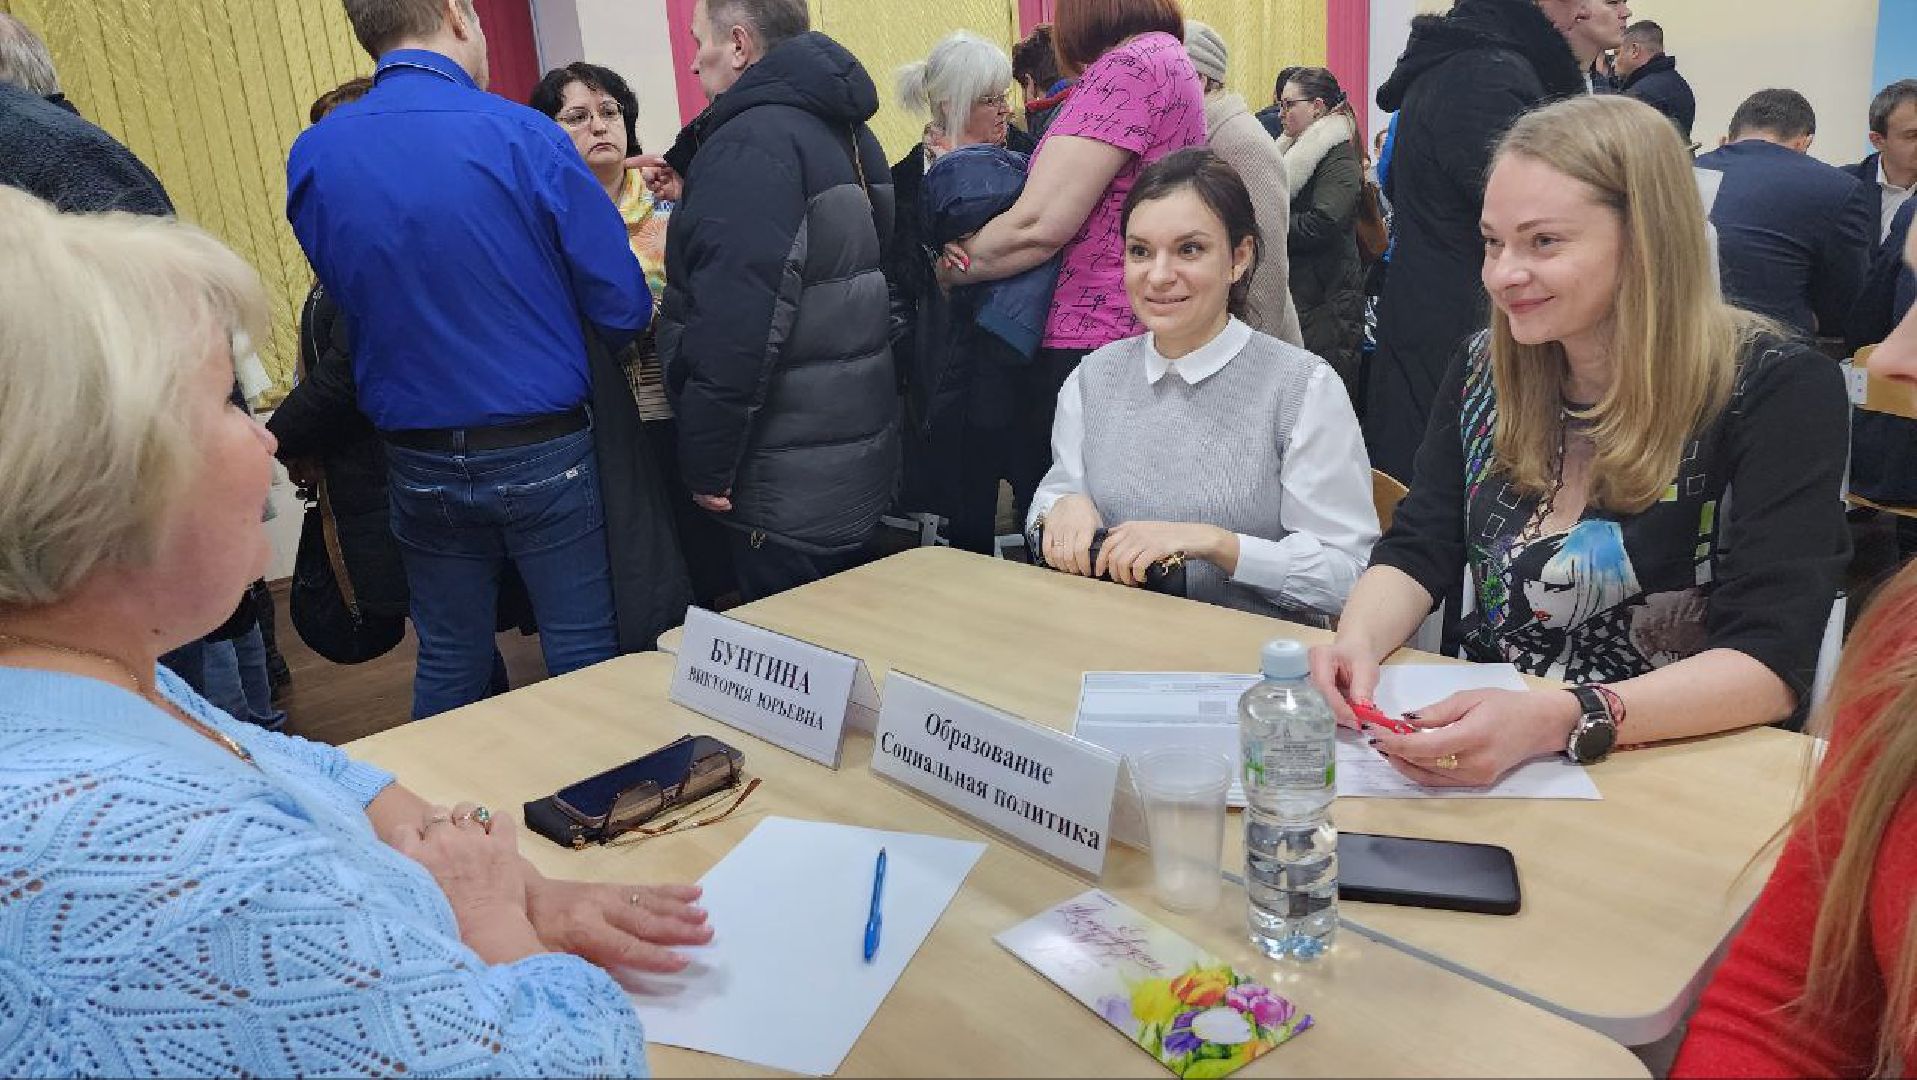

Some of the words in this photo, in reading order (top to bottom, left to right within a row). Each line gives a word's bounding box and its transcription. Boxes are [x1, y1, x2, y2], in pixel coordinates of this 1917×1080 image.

[688, 665, 753, 703] ВИКТОРИЯ
[757, 692, 823, 730] ЮРЬЕВНА
[710, 637, 811, 696] БУНТИНА
[924, 712, 1053, 784] Образование
[881, 731, 989, 799] Социальная
[993, 785, 1101, 850] политика
